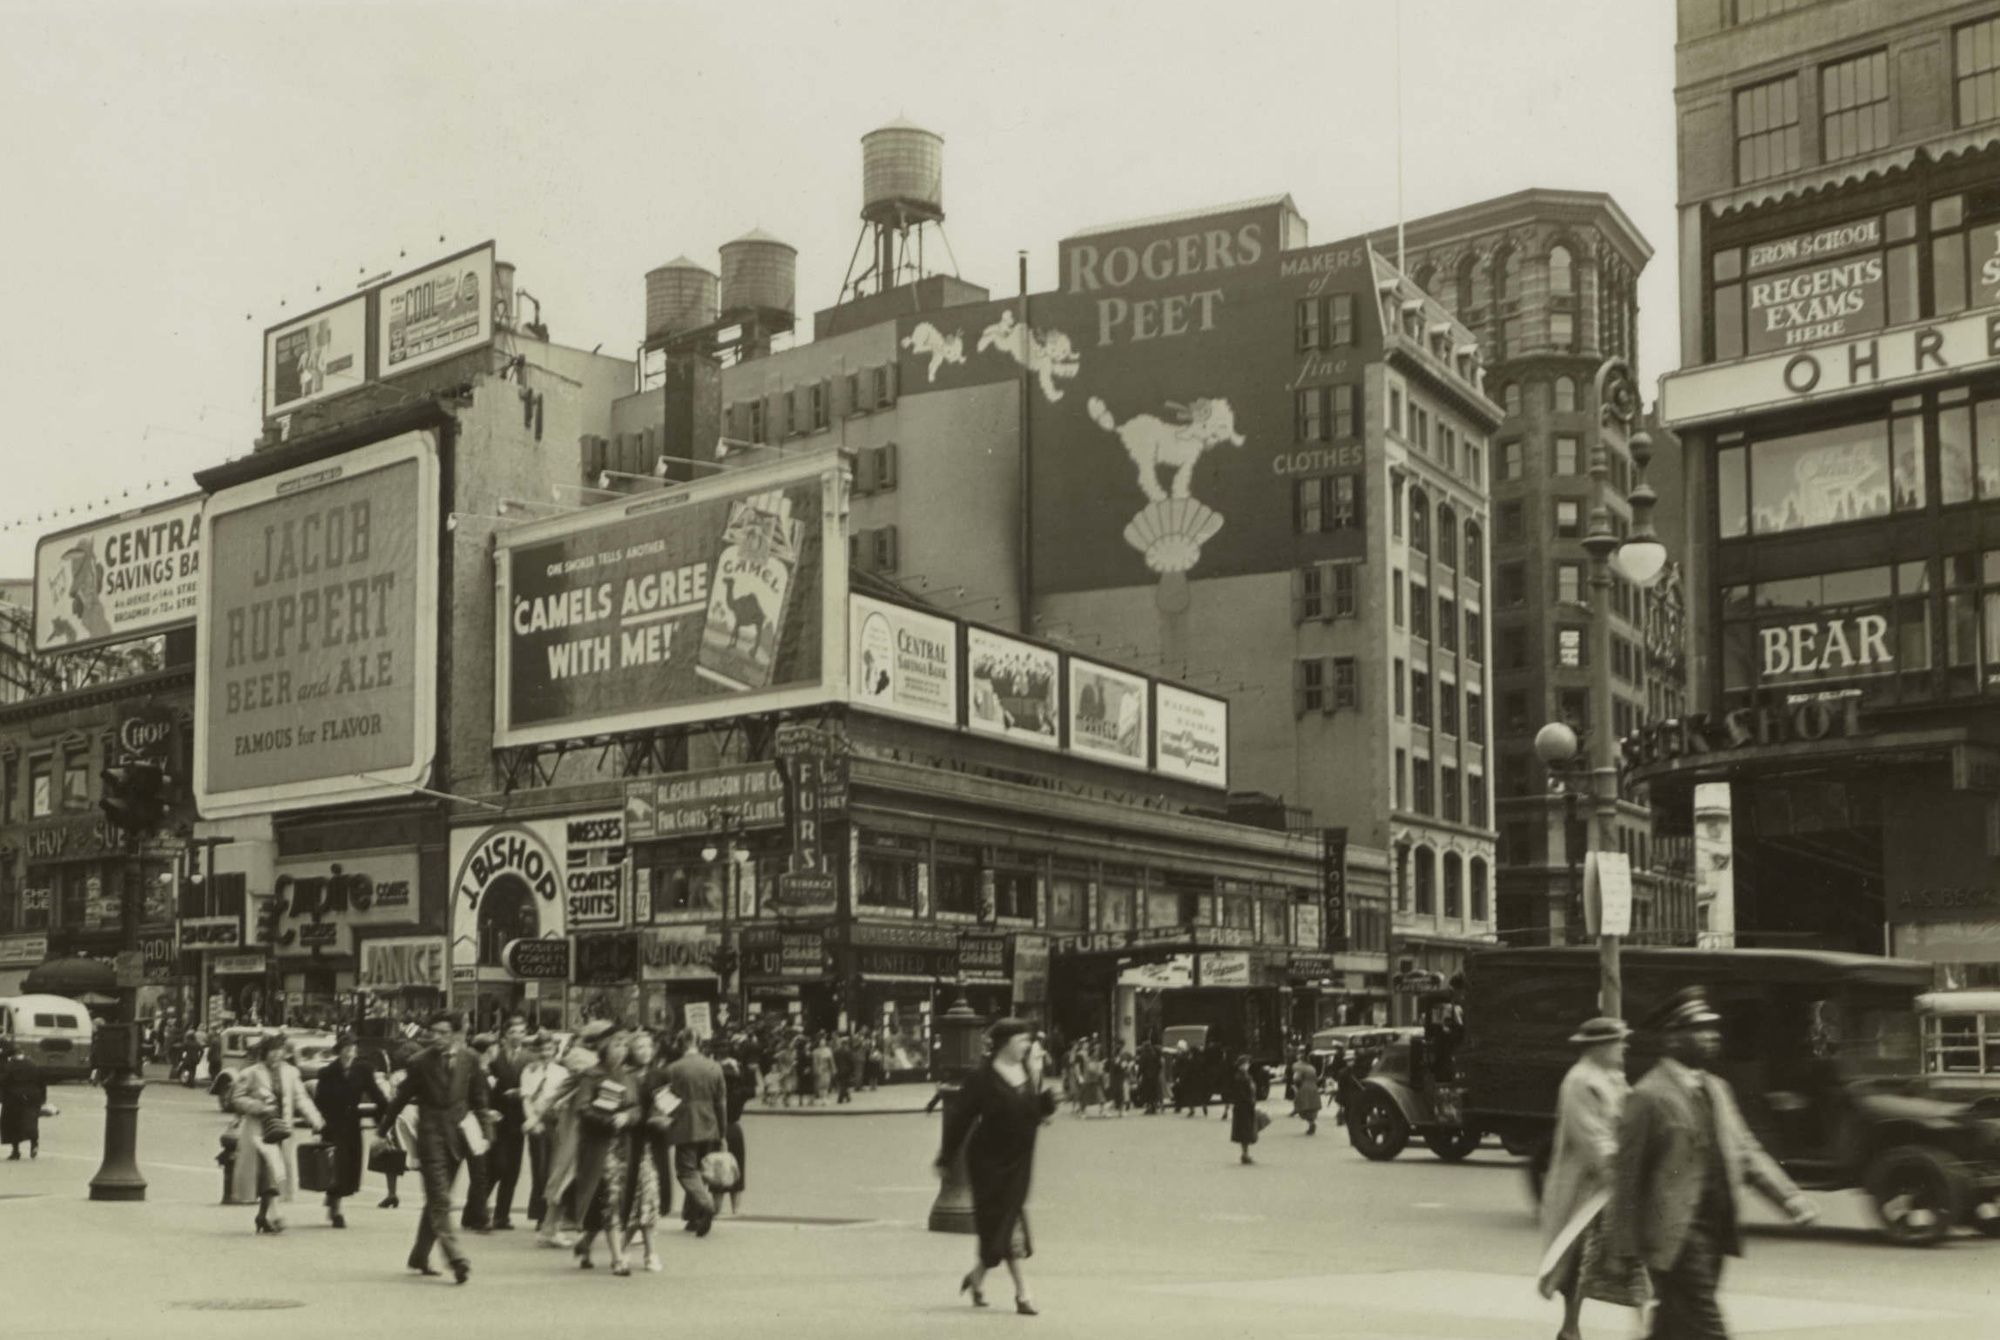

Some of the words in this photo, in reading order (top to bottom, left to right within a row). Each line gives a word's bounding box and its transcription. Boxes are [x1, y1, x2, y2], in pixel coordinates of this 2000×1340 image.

[1068, 223, 1262, 296] ROGERS
[1800, 221, 1880, 256] SCHOOL
[1281, 246, 1364, 277] MAKERS
[1751, 257, 1883, 309] REGENTS
[1096, 287, 1226, 347] PEET
[1766, 288, 1865, 332] EXAMS
[1787, 320, 1846, 345] HERE
[1293, 350, 1347, 388] fine
[1272, 444, 1364, 477] CLOTHES
[104, 512, 201, 568] CENTRA
[253, 497, 371, 588] JACOB
[598, 549, 622, 565] TELLS
[106, 557, 174, 596] SAVINGS
[620, 562, 708, 617] AGREE
[723, 560, 780, 594] CAMEL
[226, 570, 395, 669] RUPPERT
[547, 635, 612, 681] WITH
[897, 627, 947, 664] CENTRAL
[1759, 613, 1895, 677] BEAR
[226, 670, 292, 714] BEER
[297, 673, 331, 703] and
[336, 650, 393, 695] ALE
[120, 716, 171, 755] CHOP
[234, 727, 293, 757] FAMOUS
[297, 724, 317, 747] for
[321, 712, 383, 743] FLAVOR
[800, 763, 815, 869] FURS
[470, 835, 557, 902] BISHOP
[568, 871, 618, 893] COATS
[568, 893, 615, 917] SUITS
[364, 942, 442, 986] JANICE
[1059, 932, 1127, 955] FURS
